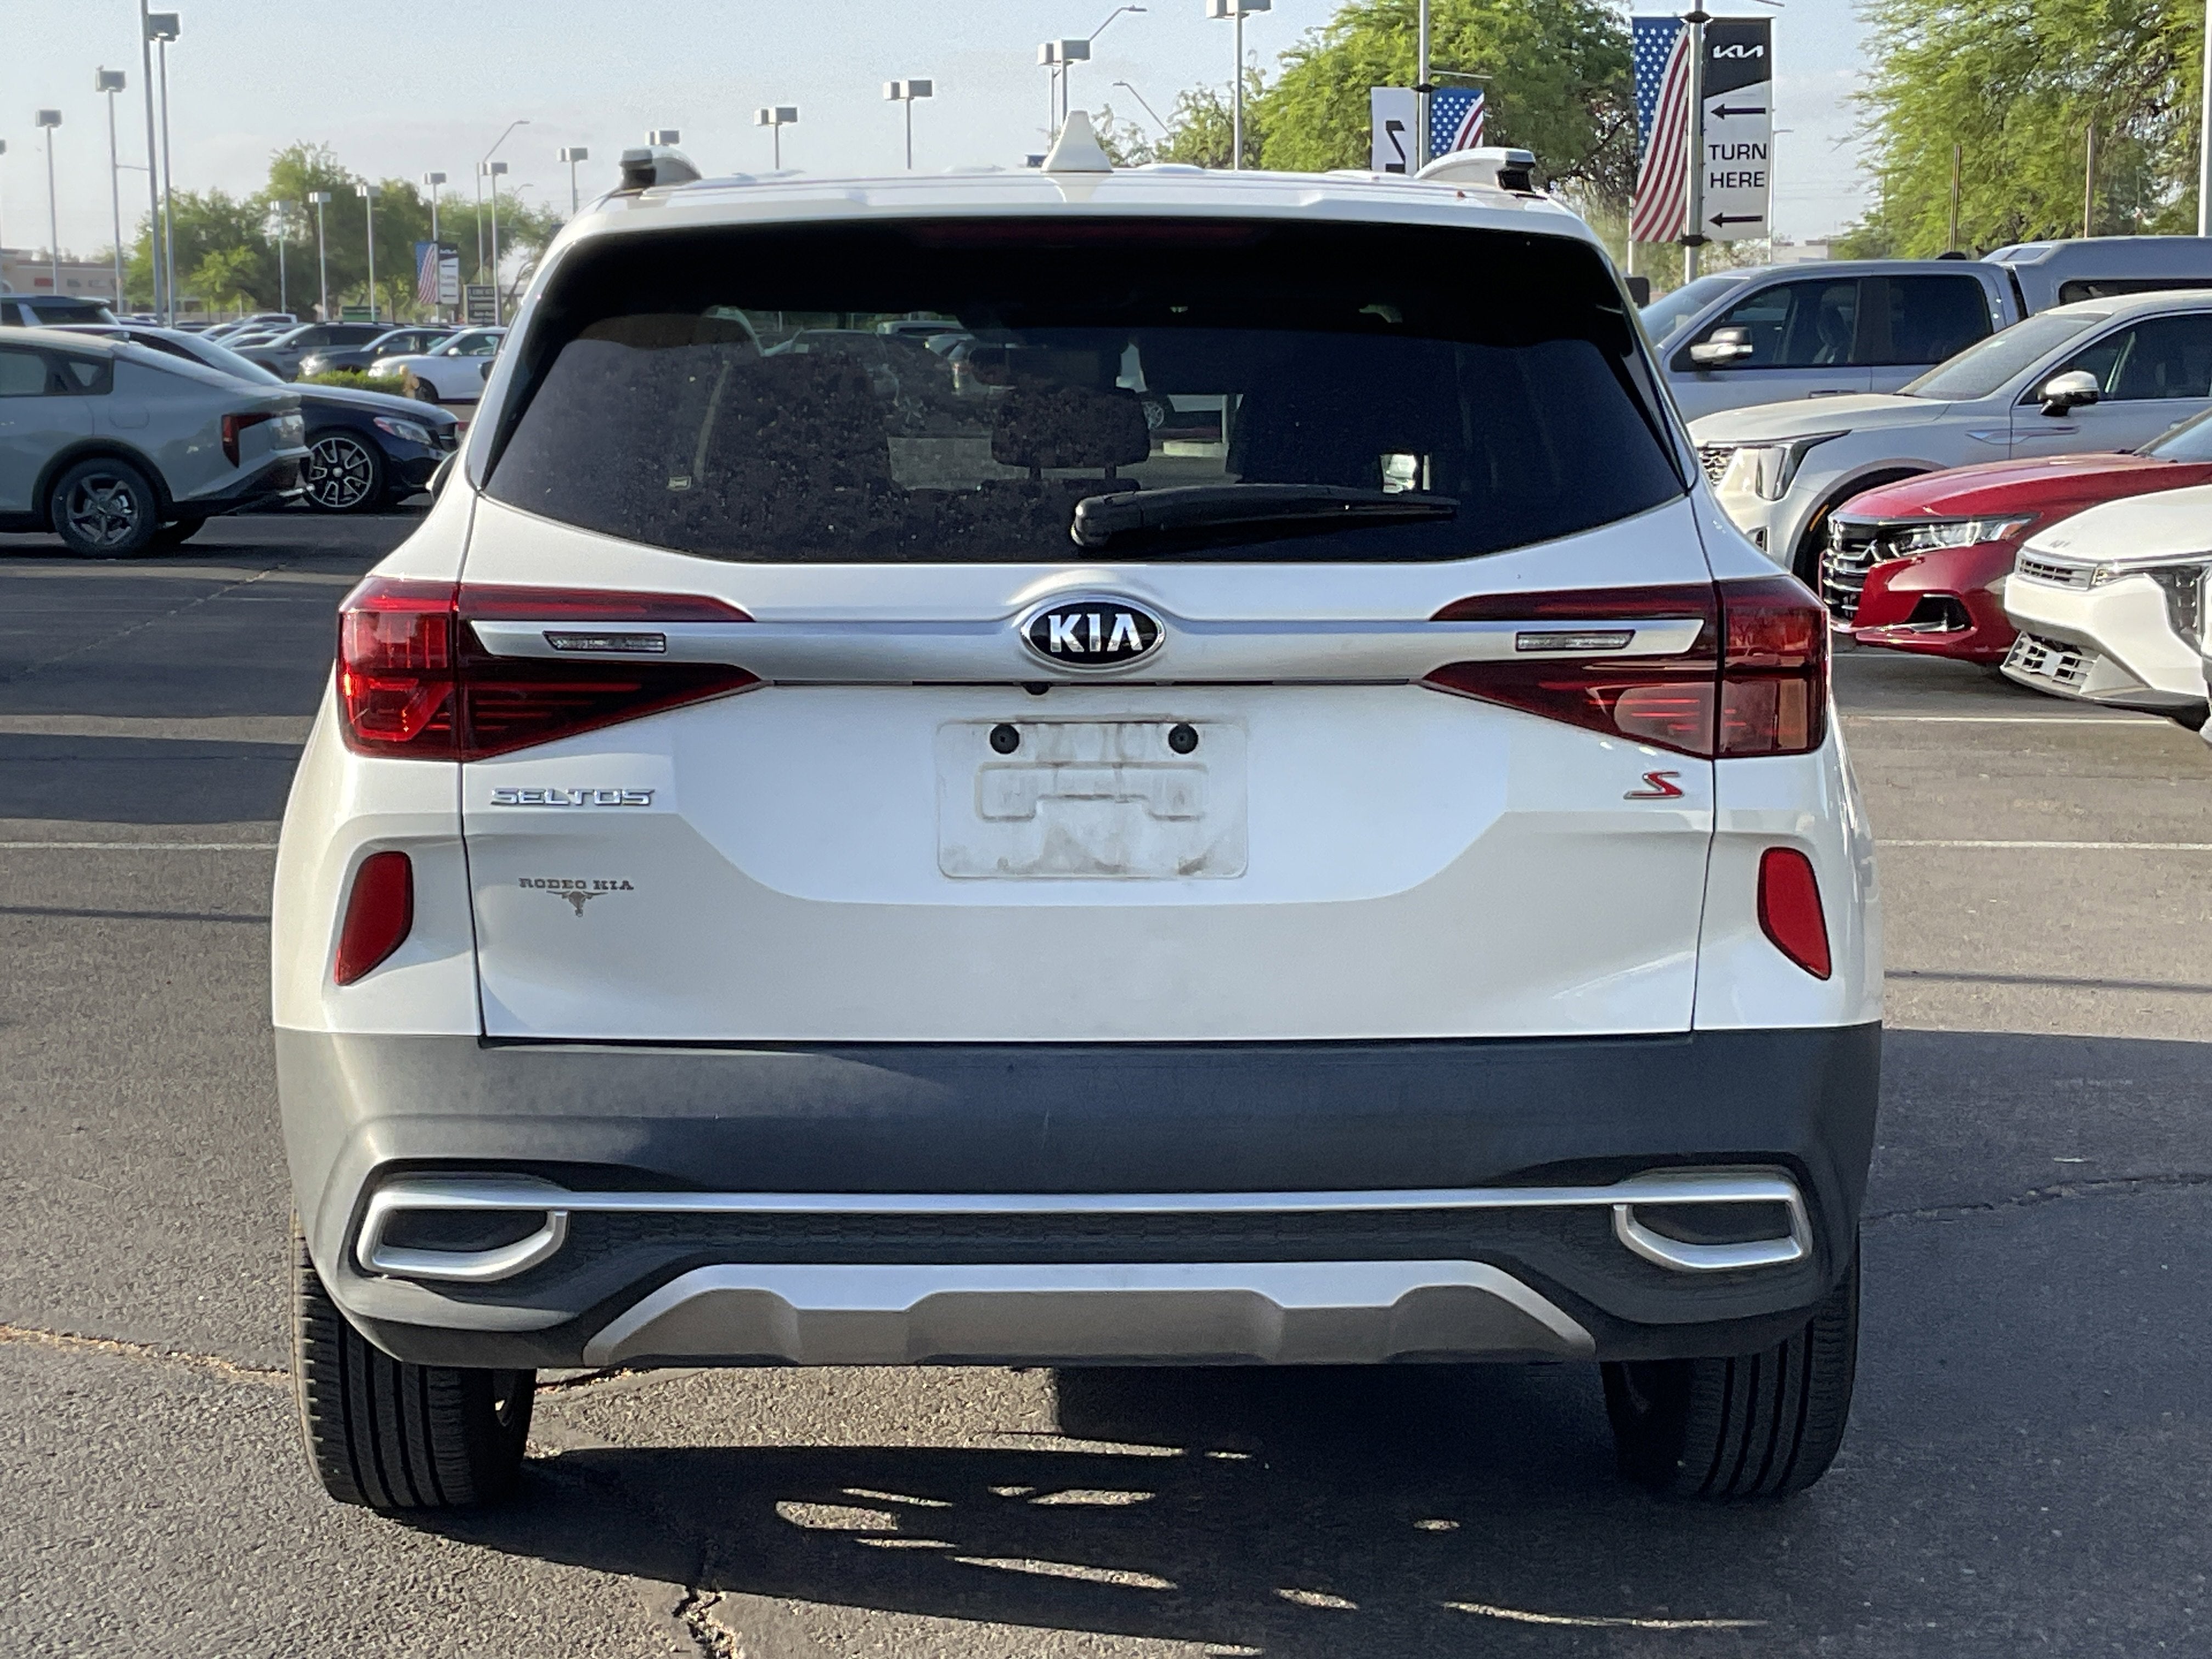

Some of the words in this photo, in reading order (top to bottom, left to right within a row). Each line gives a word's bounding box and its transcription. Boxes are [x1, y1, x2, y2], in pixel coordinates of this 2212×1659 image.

[1712, 44, 1764, 58] KIA
[1708, 143, 1767, 161] TURN
[1710, 171, 1765, 188] HERE
[1048, 613, 1143, 653] KIA
[1623, 771, 1685, 799] S
[490, 788, 655, 806] SELTOS
[519, 878, 587, 889] RODEO
[593, 879, 634, 890] KIA
